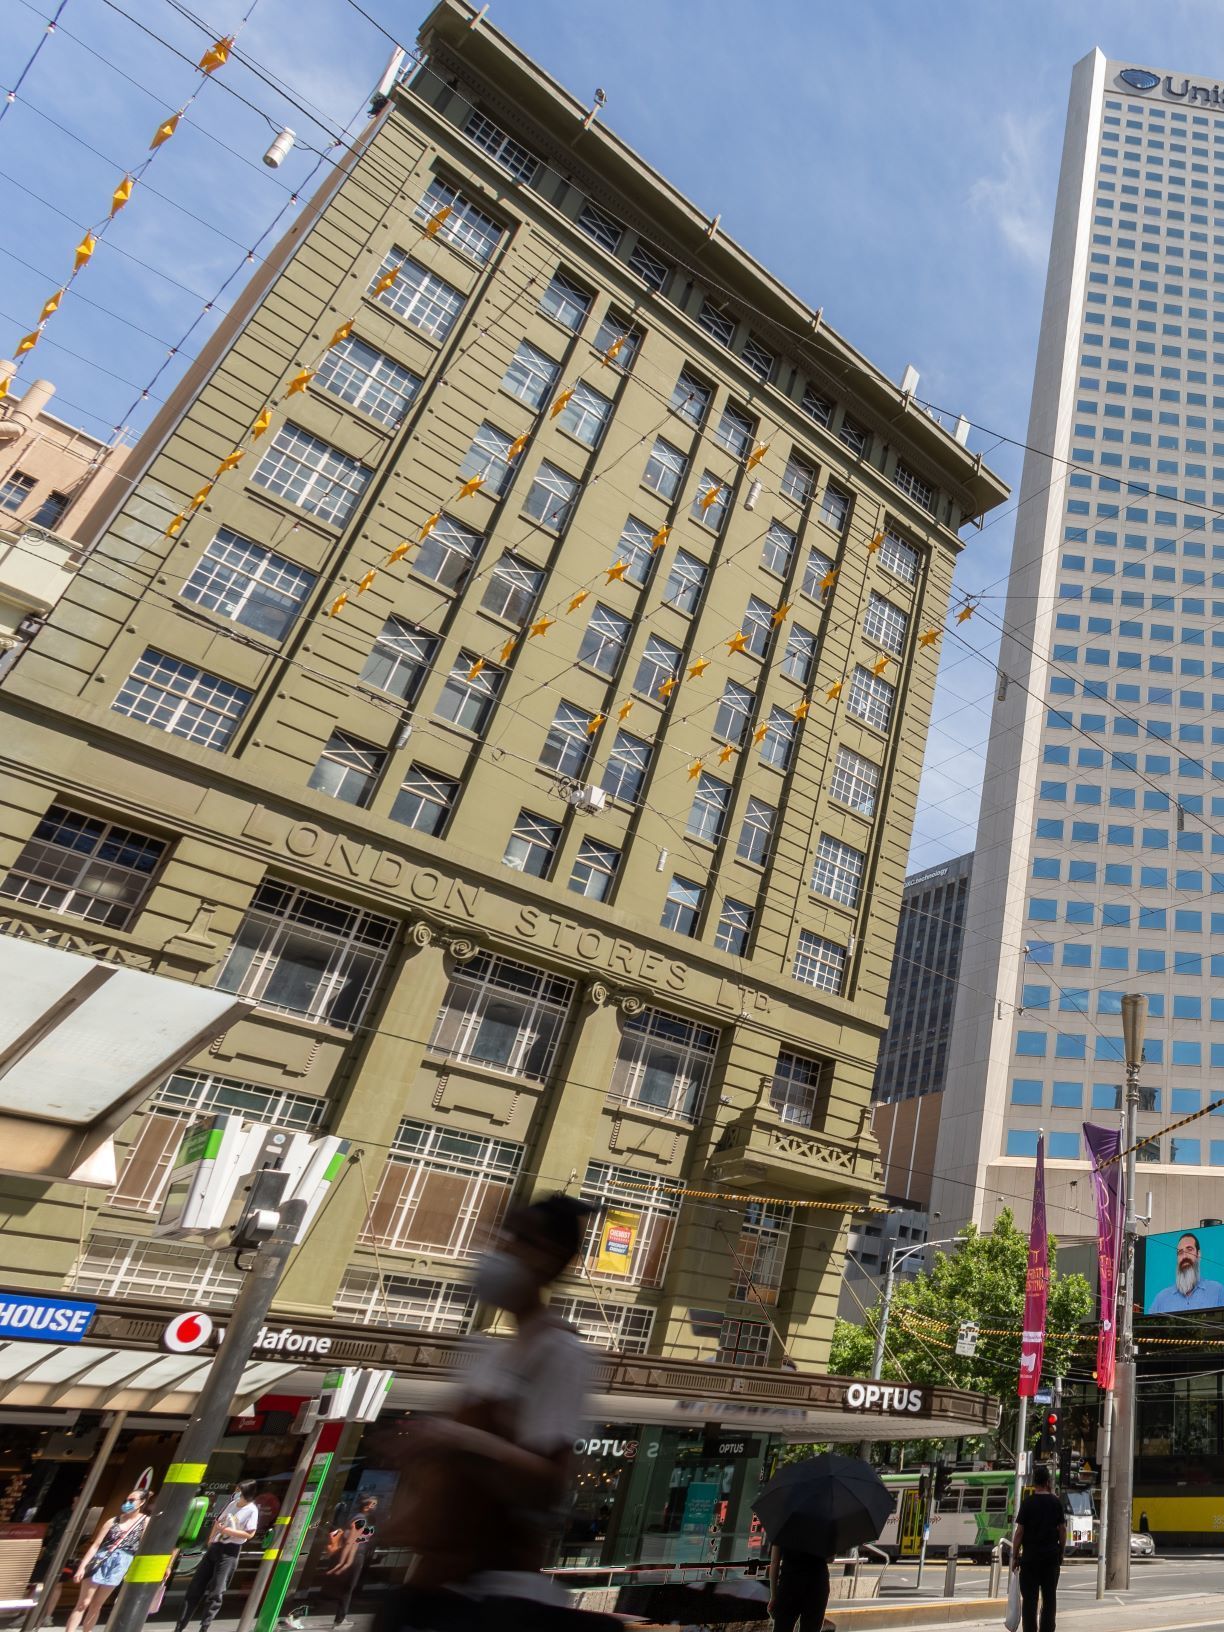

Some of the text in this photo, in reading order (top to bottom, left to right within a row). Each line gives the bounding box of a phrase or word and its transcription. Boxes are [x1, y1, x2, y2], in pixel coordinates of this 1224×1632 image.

[241, 803, 486, 918] LONDON
[514, 905, 689, 992] STORES
[847, 1383, 923, 1412] OPTUS
[573, 1438, 639, 1458] OPTUS
[718, 1443, 744, 1454] OPTUS
